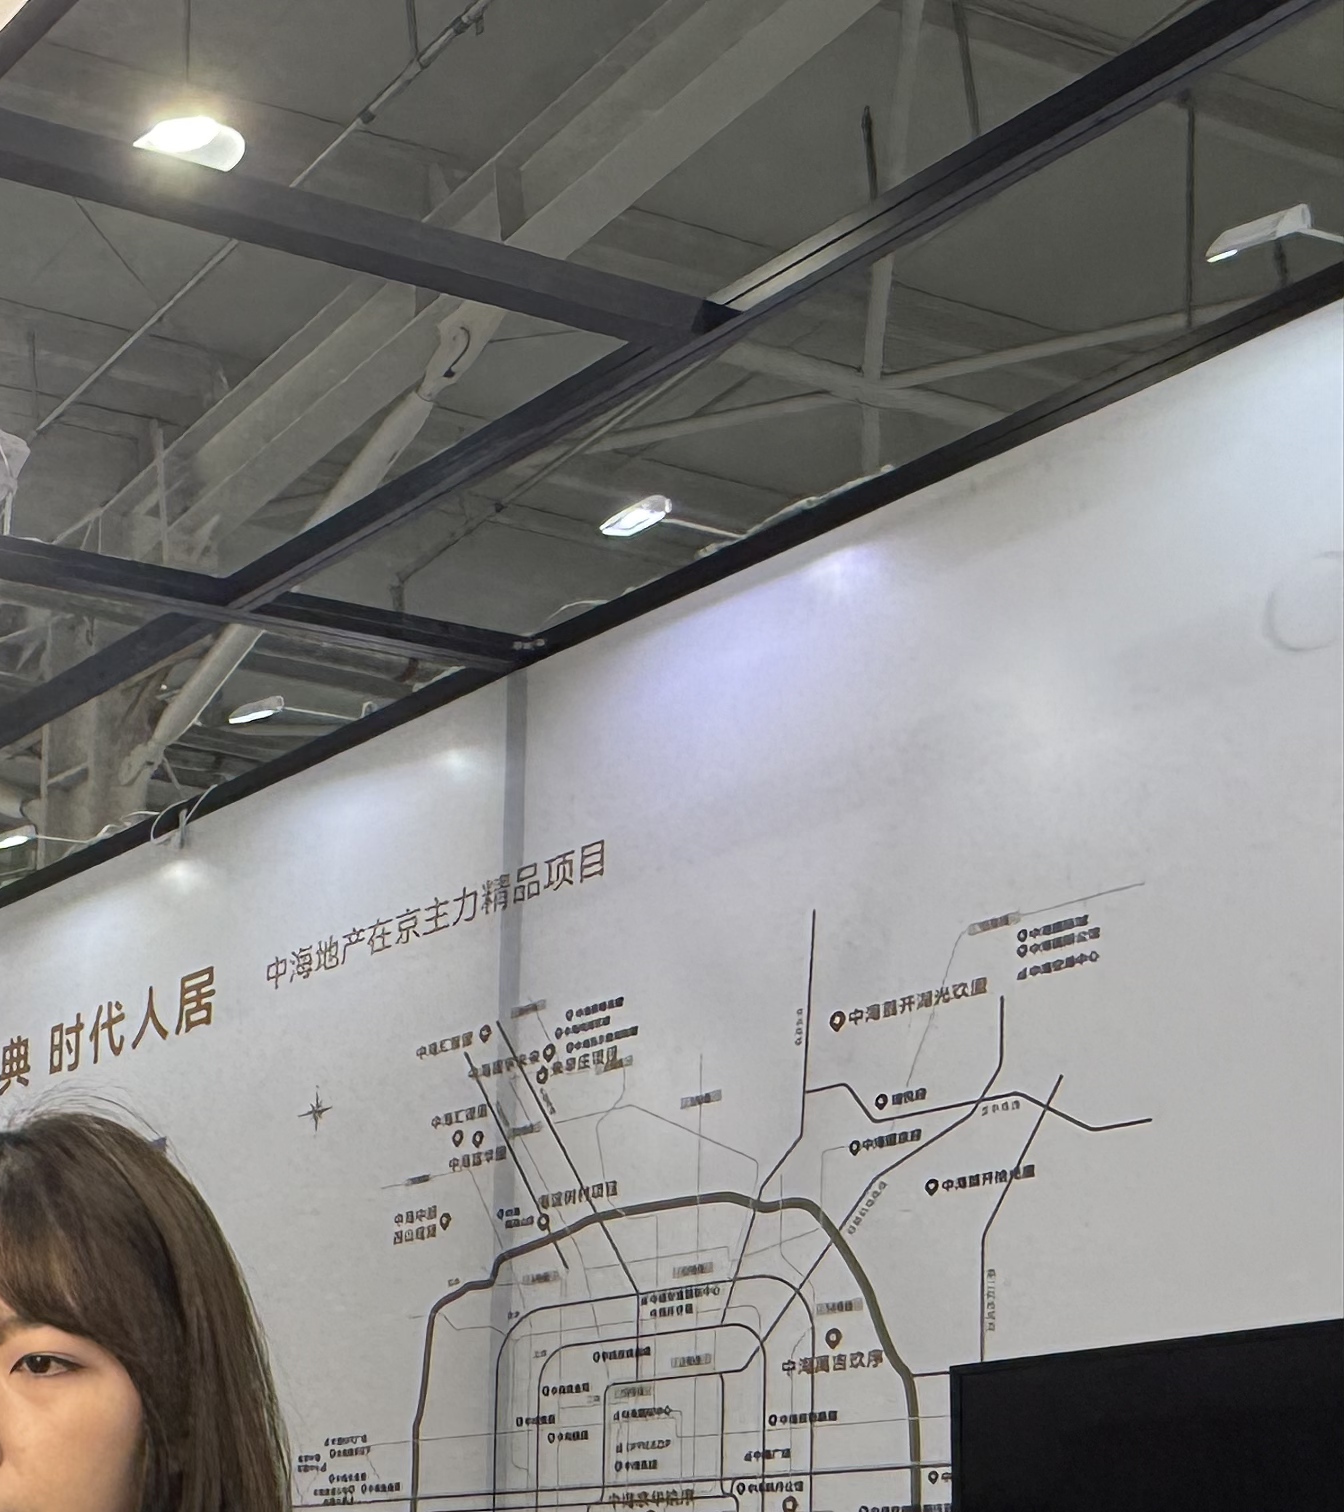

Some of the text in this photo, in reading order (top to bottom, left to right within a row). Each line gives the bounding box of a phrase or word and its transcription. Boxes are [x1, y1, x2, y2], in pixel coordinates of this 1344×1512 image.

[265, 839, 605, 990] 中海地产在京主力精品项目
[48, 965, 216, 1075] 时代人居
